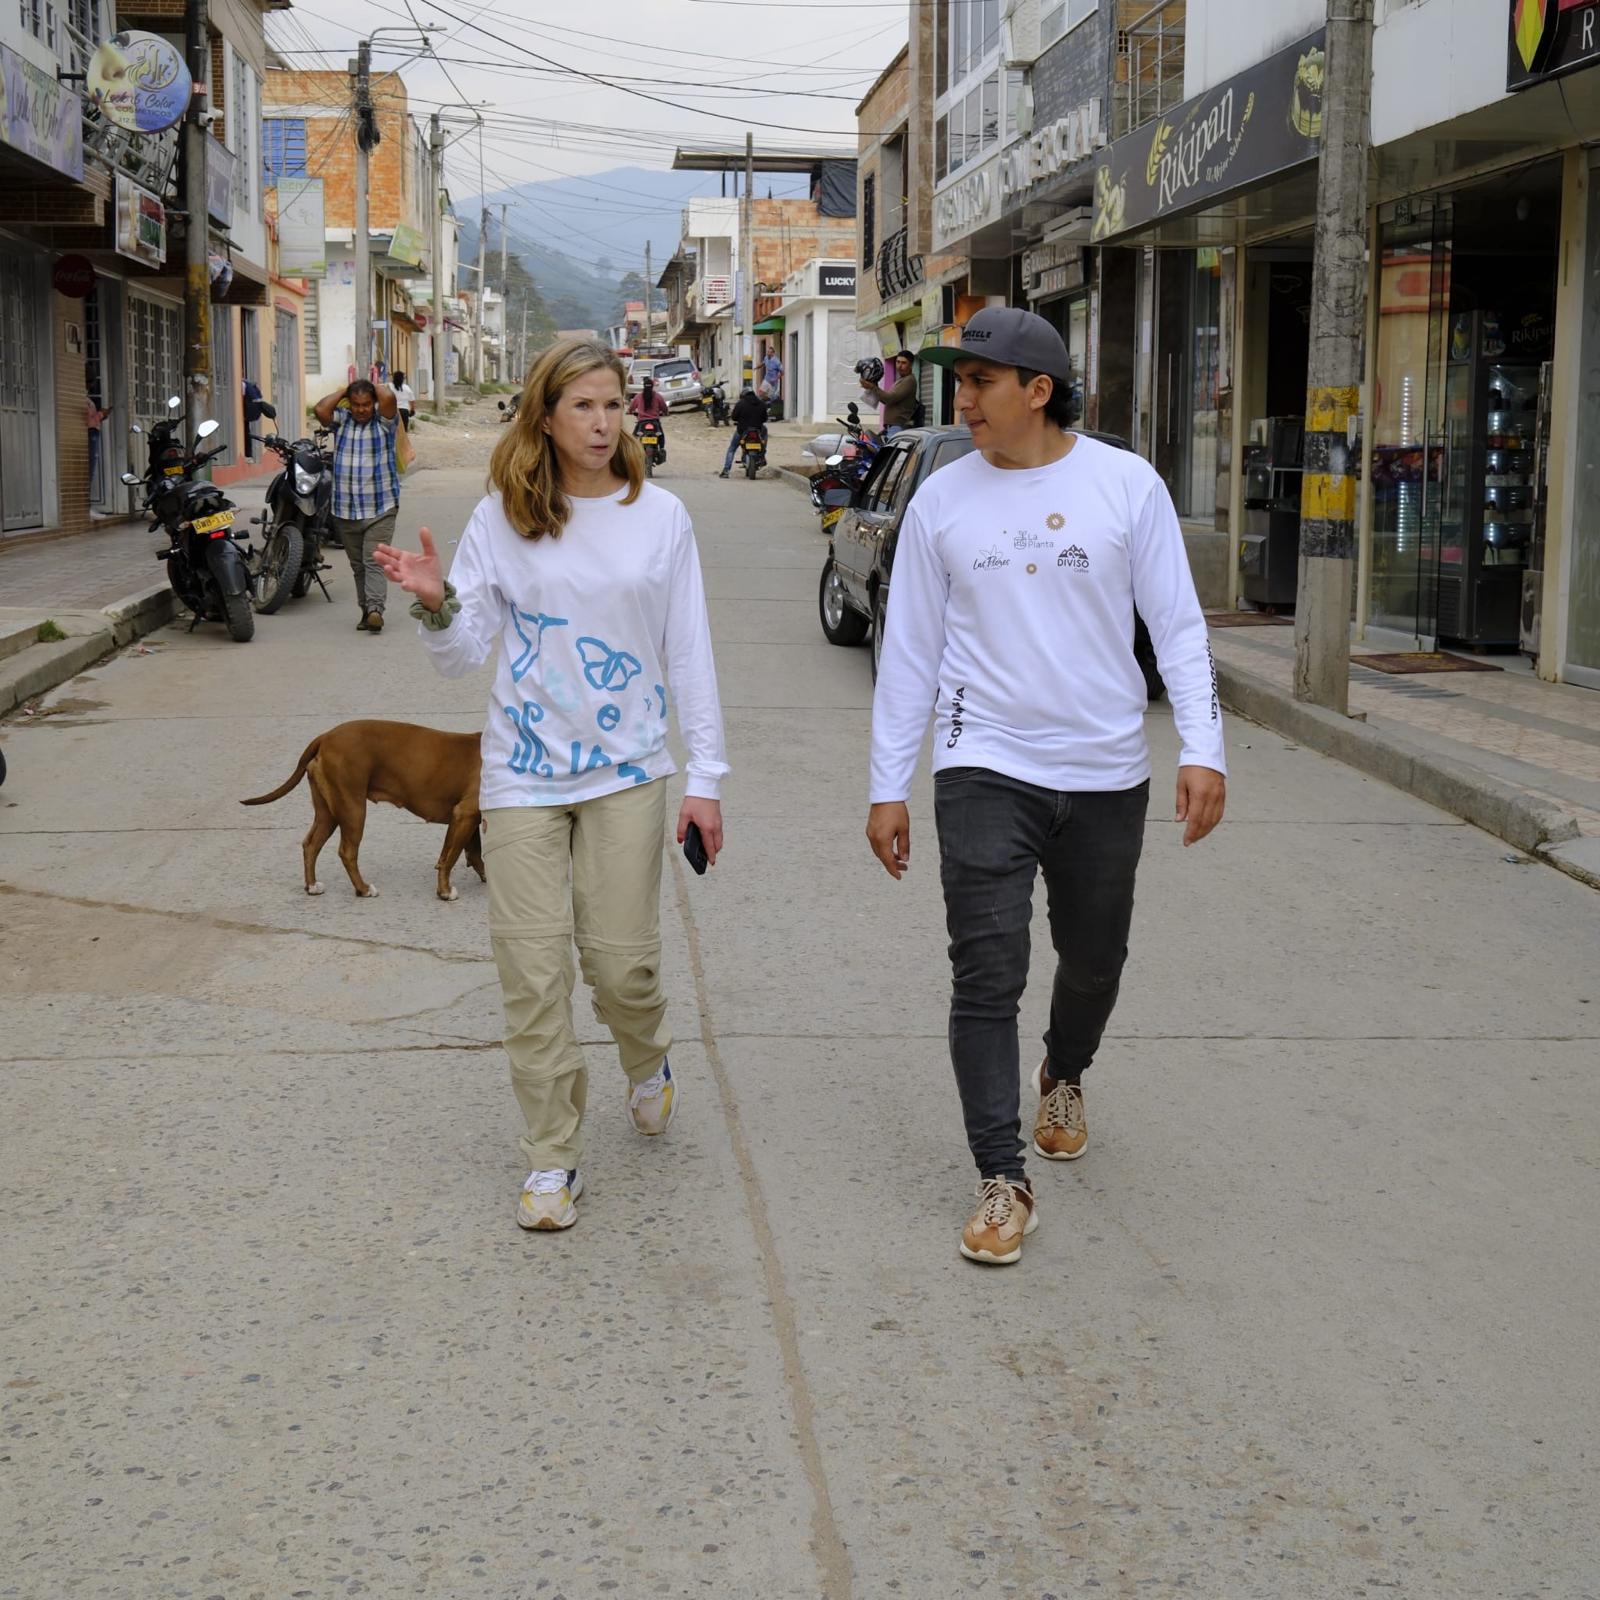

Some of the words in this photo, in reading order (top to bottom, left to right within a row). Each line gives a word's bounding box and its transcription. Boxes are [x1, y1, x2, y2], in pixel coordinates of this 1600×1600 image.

[144, 93, 175, 109] Color
[1157, 87, 1233, 213] Rikipan
[824, 276, 855, 286] LUCKY
[1028, 540, 1054, 549] Planta
[1057, 558, 1090, 568] DIVISO
